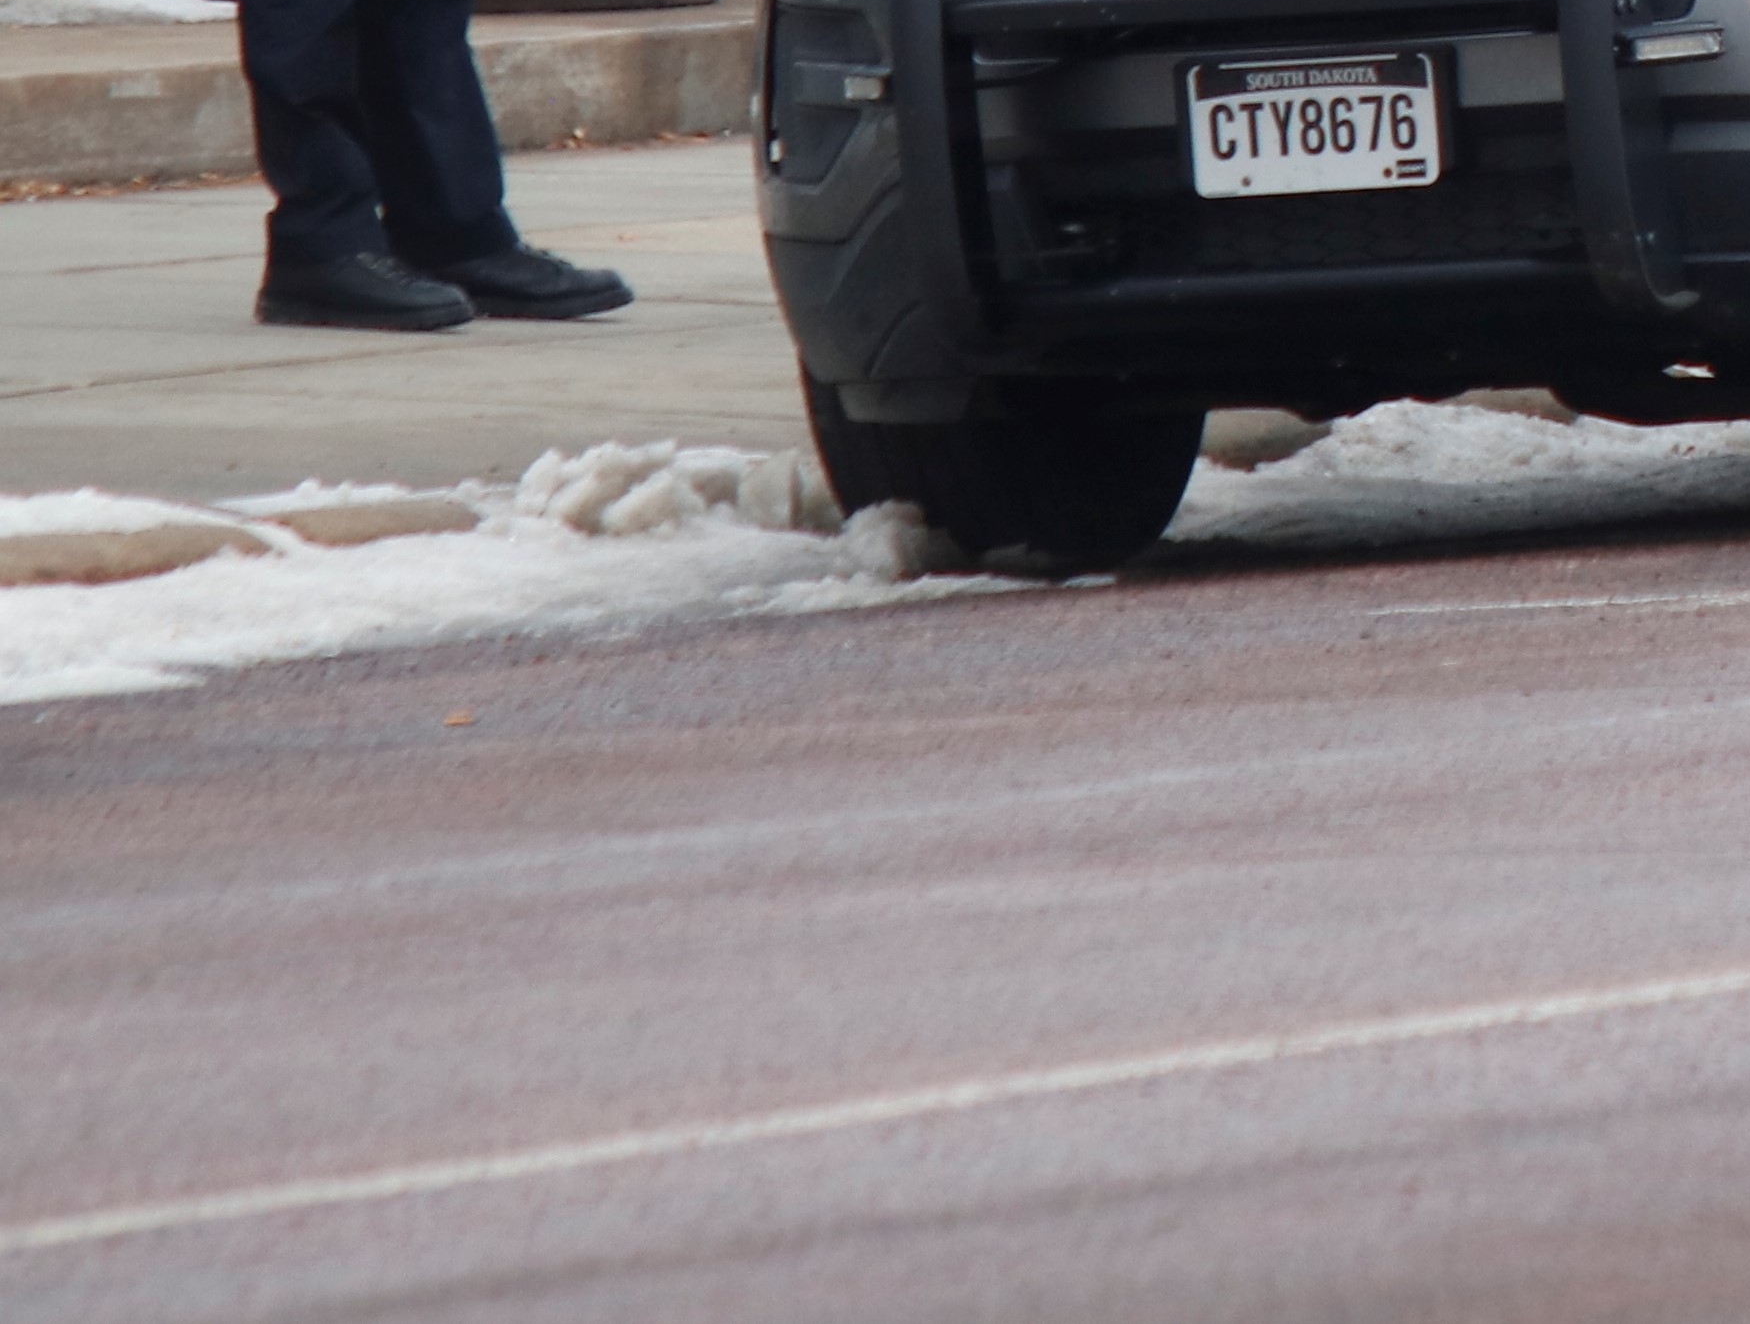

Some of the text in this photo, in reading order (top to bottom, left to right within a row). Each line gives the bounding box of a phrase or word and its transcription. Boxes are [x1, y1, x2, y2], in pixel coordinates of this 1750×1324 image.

[1246, 66, 1378, 92] SOUTH DAKOTA
[1209, 93, 1417, 161] CTY8676
